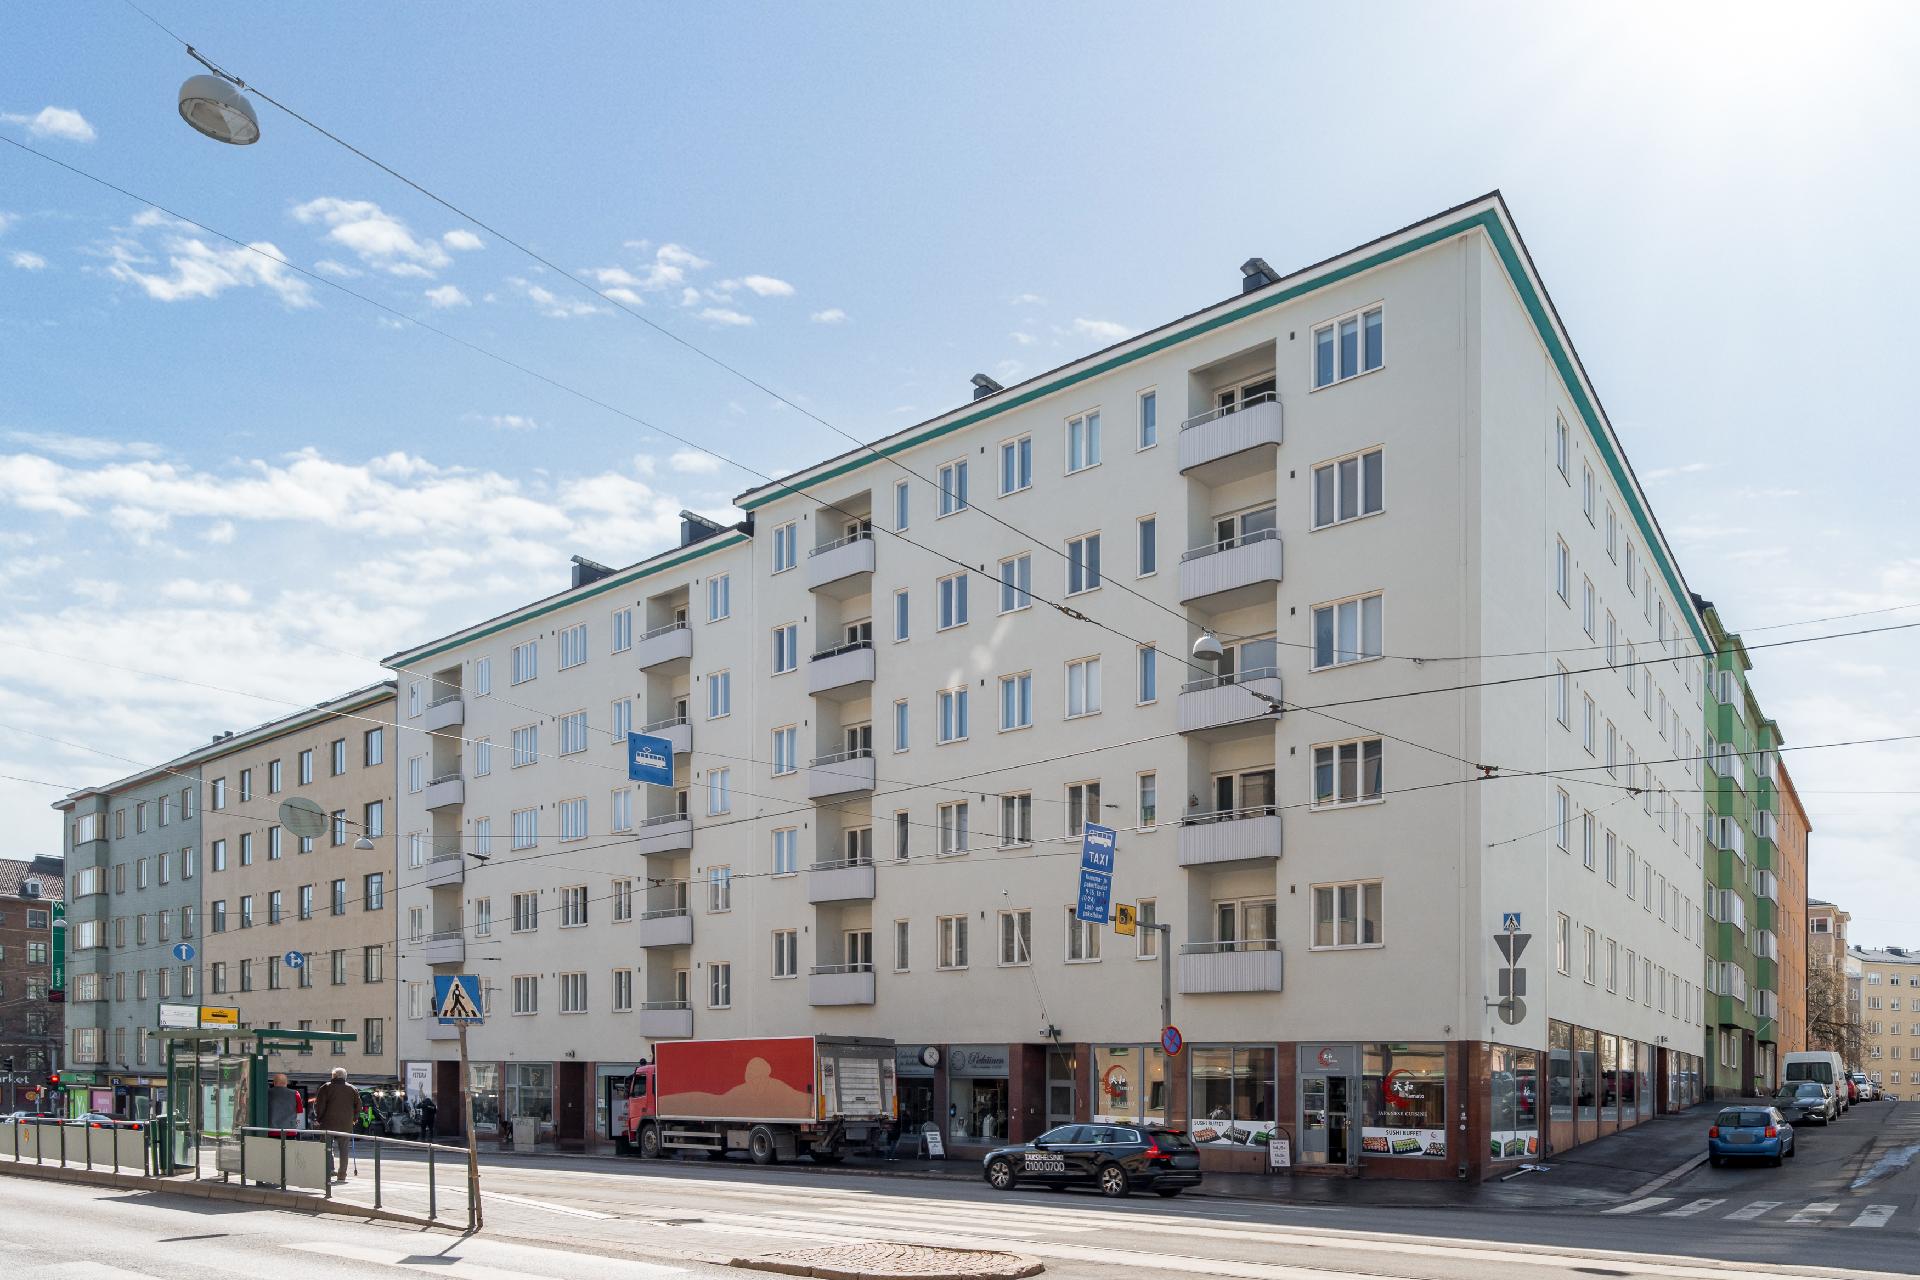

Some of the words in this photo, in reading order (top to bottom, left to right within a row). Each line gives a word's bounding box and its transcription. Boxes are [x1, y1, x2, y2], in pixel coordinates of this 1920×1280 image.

[1089, 852, 1108, 866] TAXI
[1025, 1161, 1044, 1171] 0100
[1044, 1161, 1065, 1172] 0700
